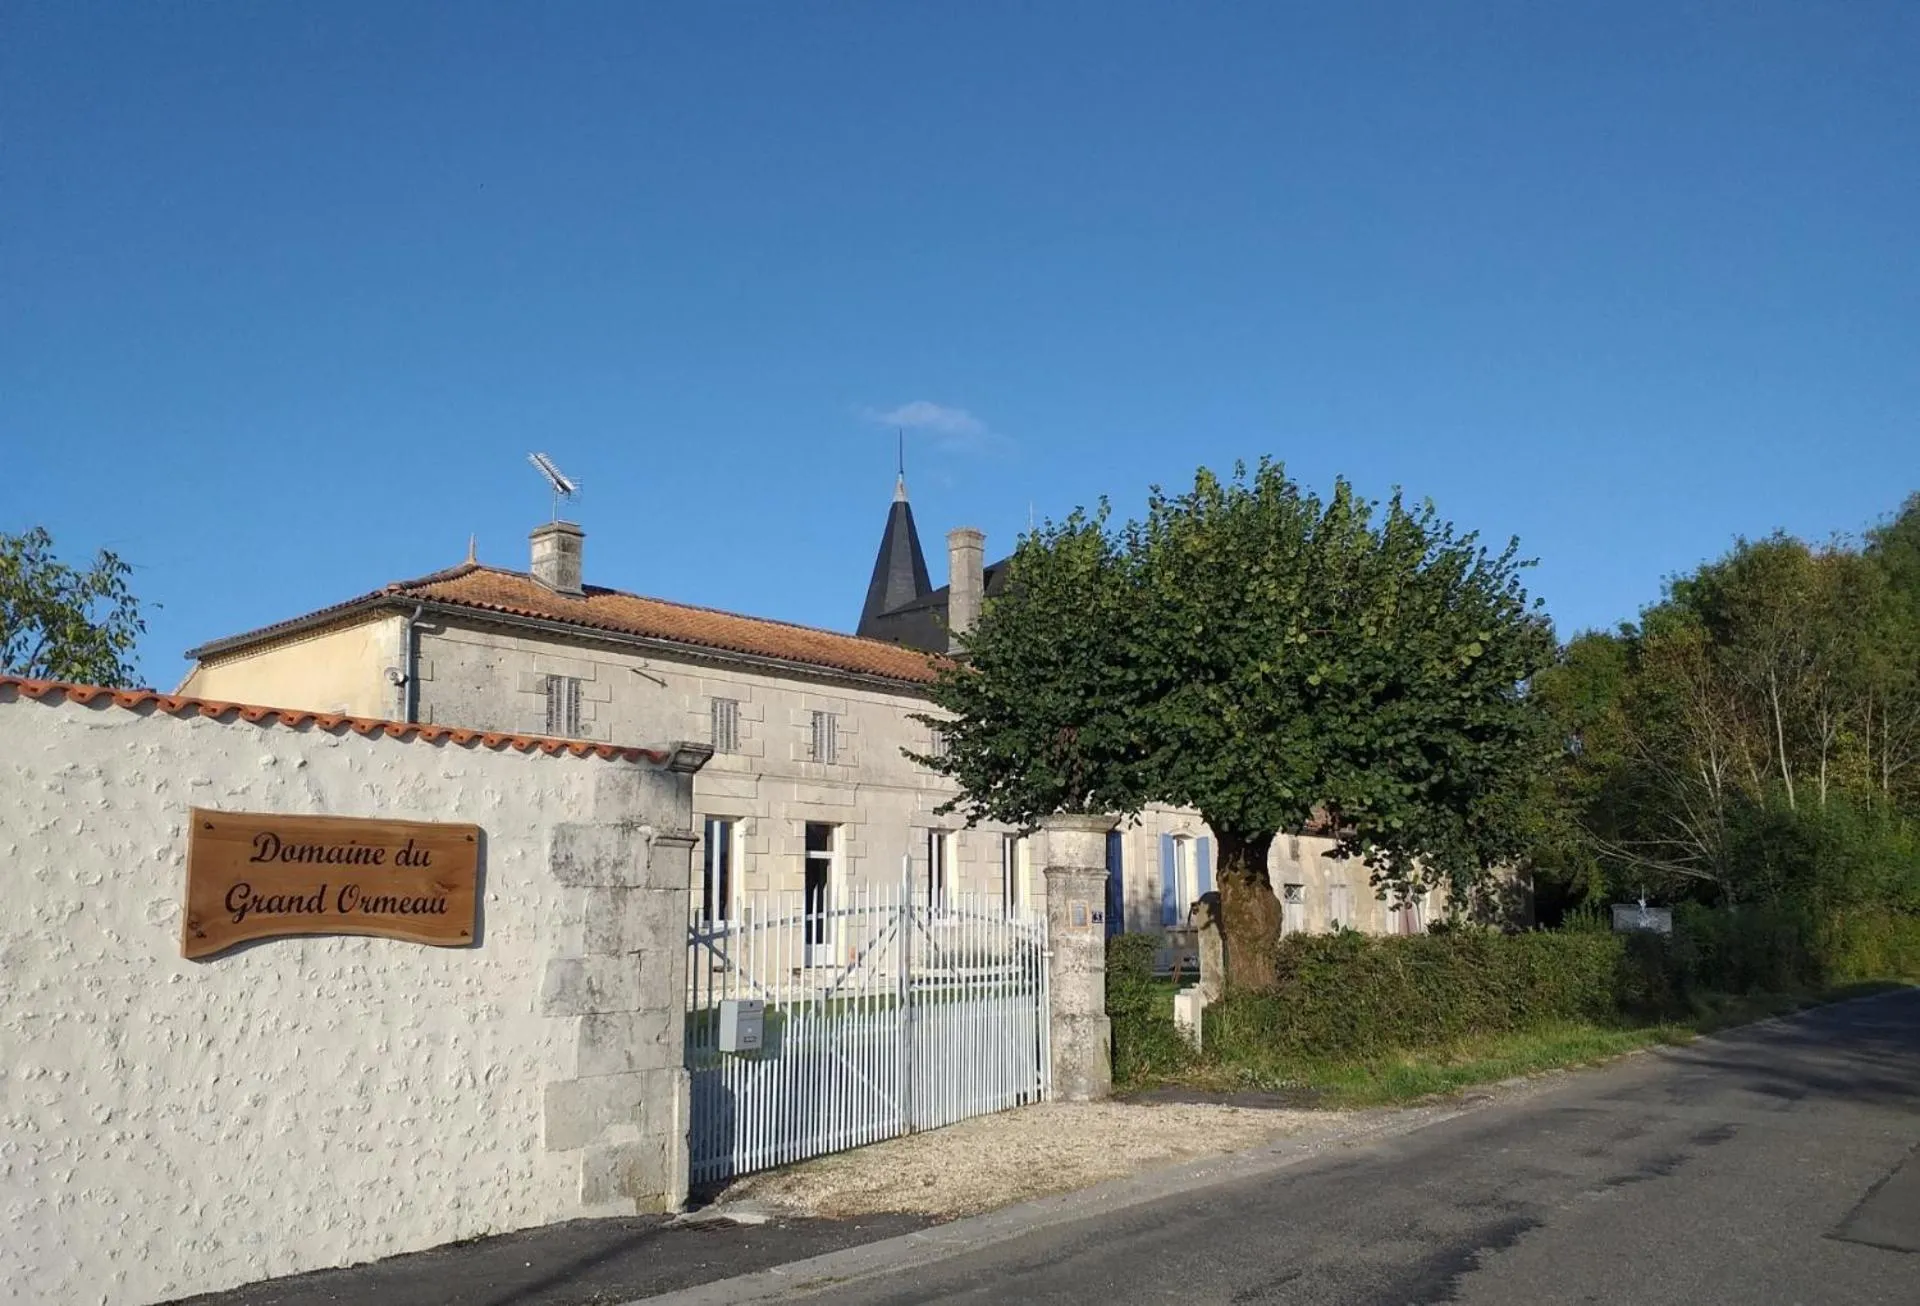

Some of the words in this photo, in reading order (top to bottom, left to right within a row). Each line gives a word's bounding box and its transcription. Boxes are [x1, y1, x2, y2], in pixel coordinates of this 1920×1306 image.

[250, 832, 386, 866] Domaine
[395, 838, 432, 867] du
[225, 883, 327, 923] Grand
[338, 884, 448, 914] Ormeau
